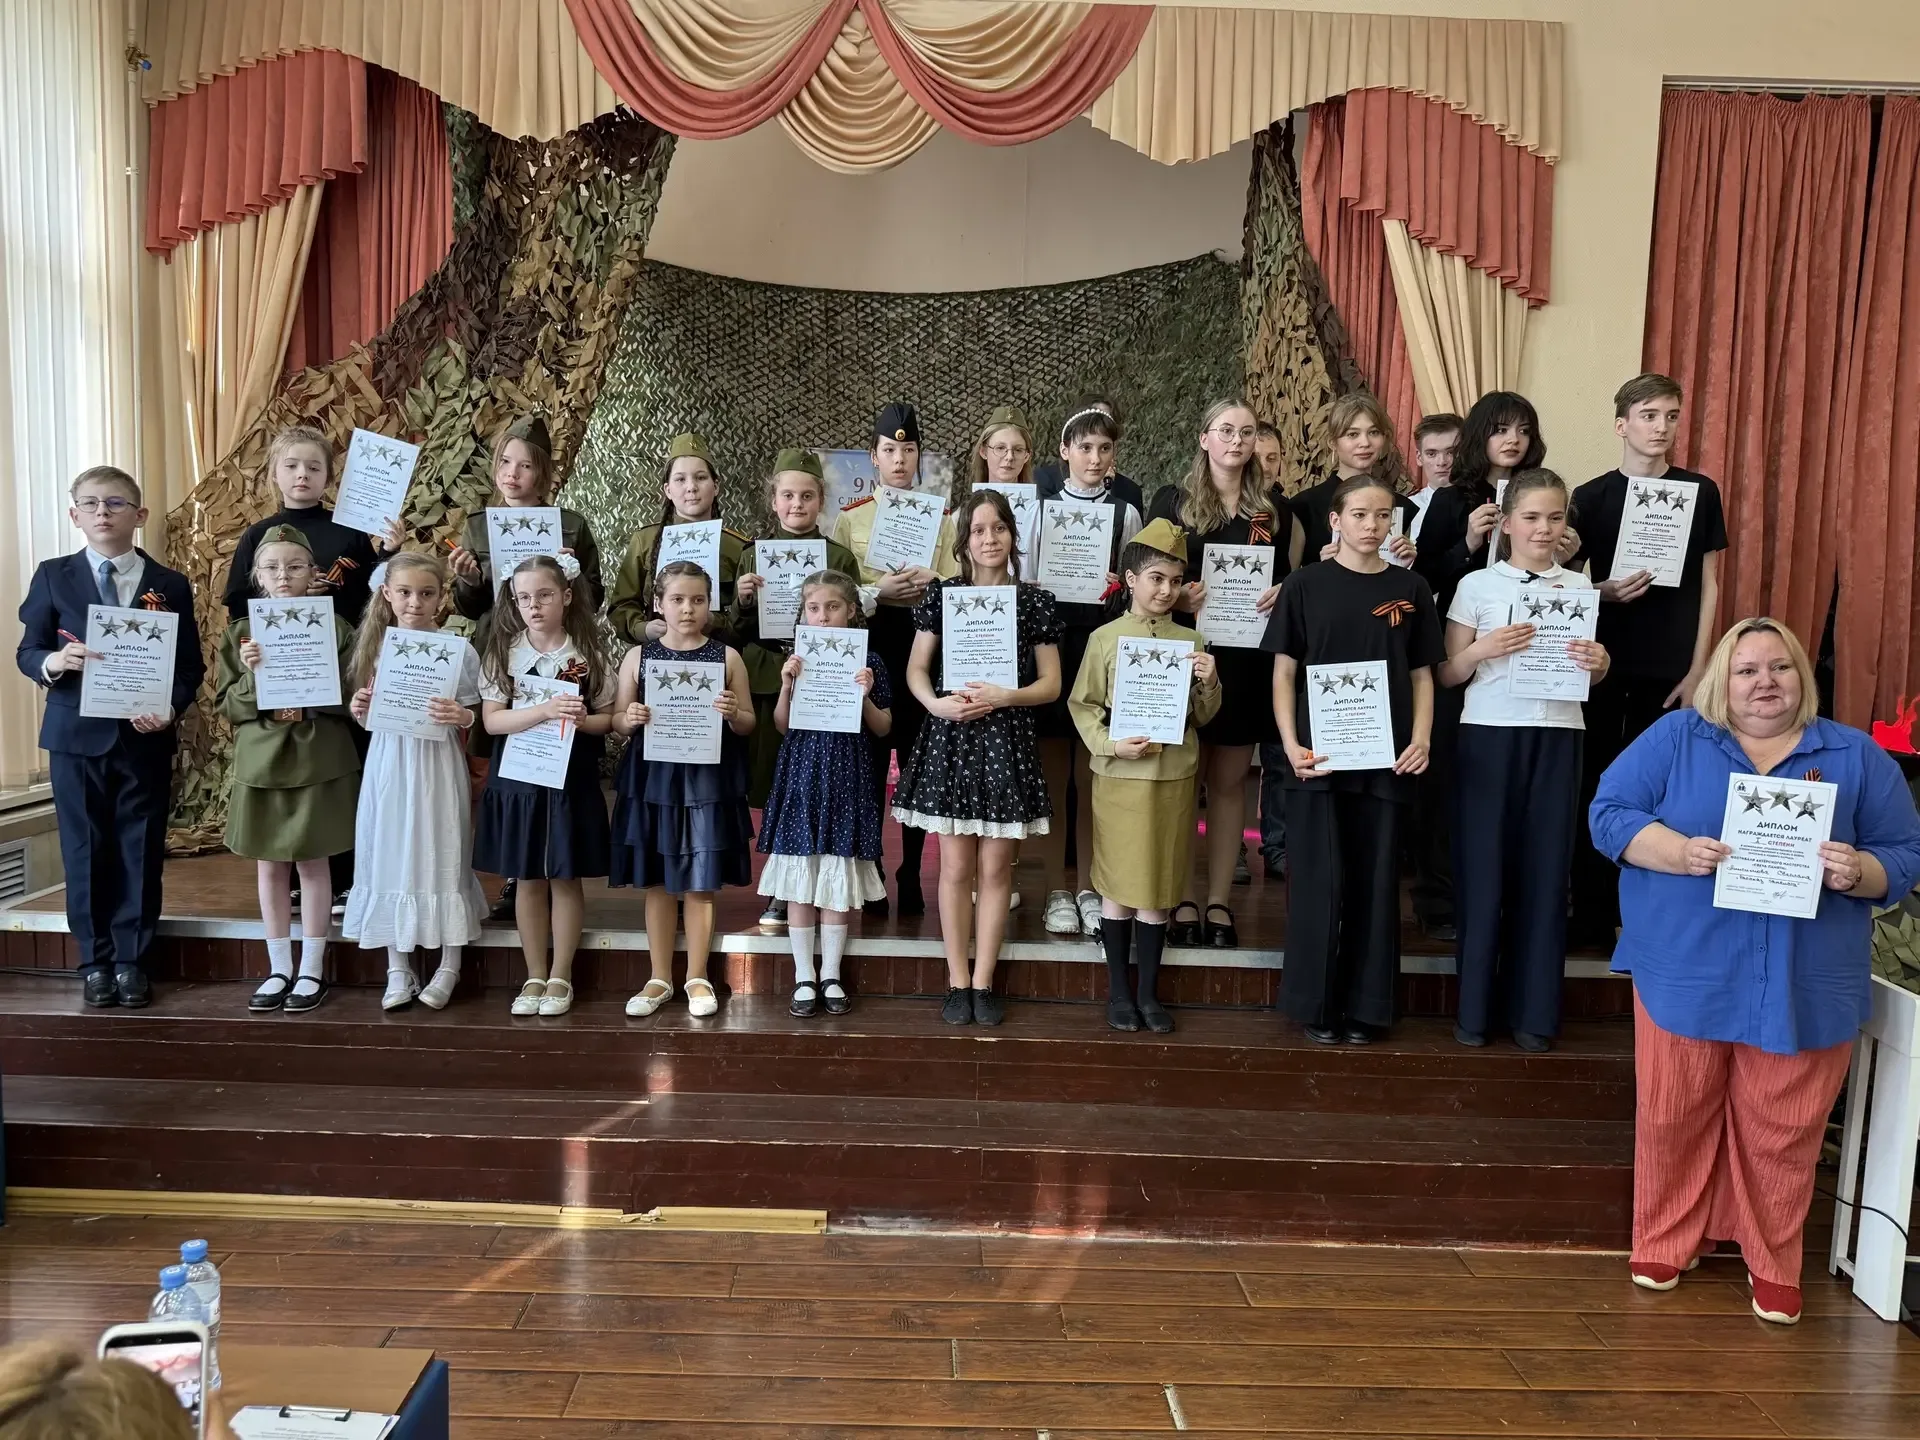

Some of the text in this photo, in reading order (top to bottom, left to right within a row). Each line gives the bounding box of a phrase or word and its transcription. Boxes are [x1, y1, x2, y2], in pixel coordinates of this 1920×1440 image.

[365, 464, 390, 476] ДИПЛОМ
[853, 476, 865, 493] 9
[895, 513, 921, 523] ДИПЛОМ
[114, 644, 148, 652] ДИПЛОМ
[404, 663, 435, 672] ДИПЛОМ
[1756, 821, 1798, 831] ДИПЛОМ
[1737, 829, 1812, 842] НАГРАЖДАЕТСЯ ЛАУРЕАТ
